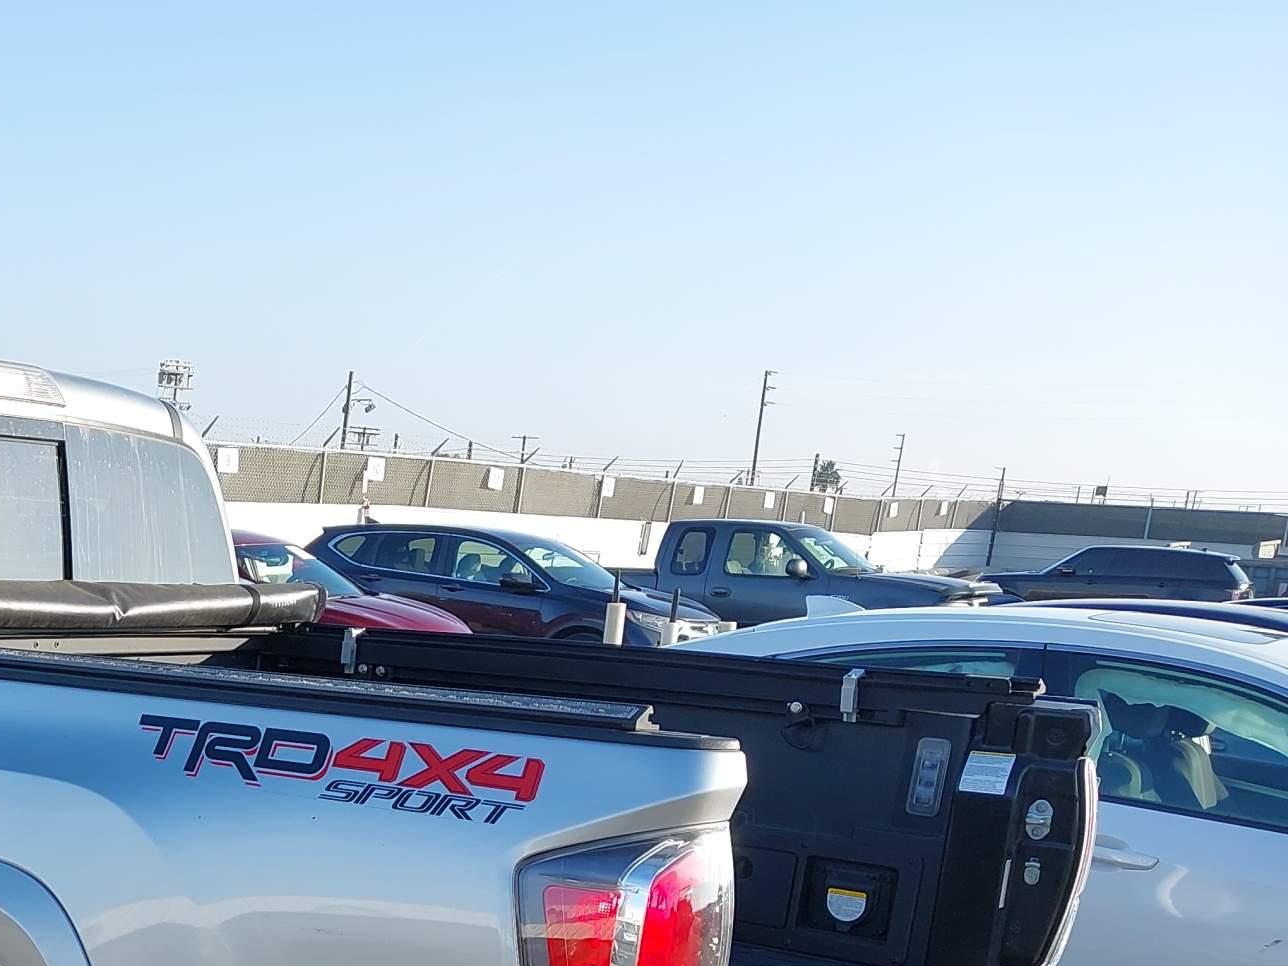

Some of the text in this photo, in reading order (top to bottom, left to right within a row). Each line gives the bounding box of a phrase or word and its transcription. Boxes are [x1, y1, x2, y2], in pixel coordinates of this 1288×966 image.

[139, 714, 545, 802] TRD 4X4
[318, 780, 525, 824] SPORT
